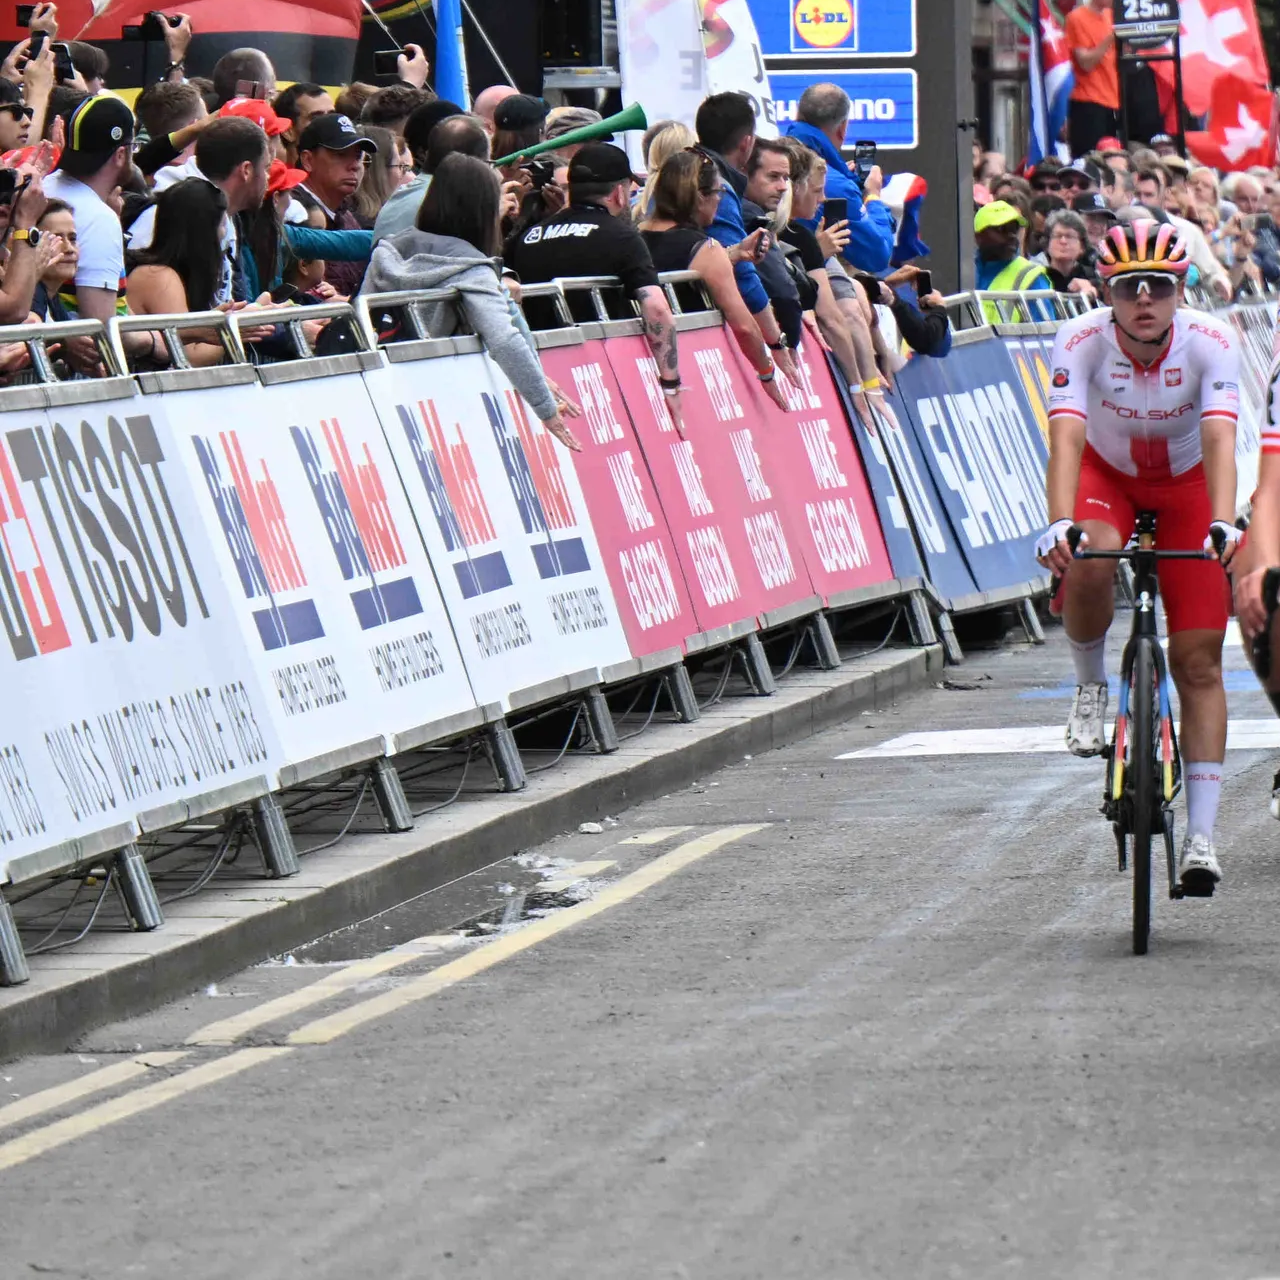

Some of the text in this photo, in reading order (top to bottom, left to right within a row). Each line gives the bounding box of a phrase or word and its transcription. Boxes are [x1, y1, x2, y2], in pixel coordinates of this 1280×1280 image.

[542, 224, 595, 240] MAPEI
[1064, 325, 1104, 352] POLSKA
[1188, 323, 1231, 350] POLSKA
[1101, 400, 1195, 420] POLSKA
[396, 399, 498, 590] BigMat
[606, 450, 655, 533] MAKE
[670, 441, 714, 517] MAKE
[729, 428, 771, 502] MAKE
[797, 419, 848, 490] MAKE
[5, 415, 211, 643] TISSOT
[192, 430, 308, 635] BigMat
[289, 418, 407, 615] BigMat
[743, 510, 796, 591] GLASGOW
[804, 498, 871, 573] GLASGOW
[619, 539, 682, 631] GLASGOW
[686, 525, 741, 607] GLASGOW
[44, 680, 268, 822] SWISS WATCHES SINCE 1853
